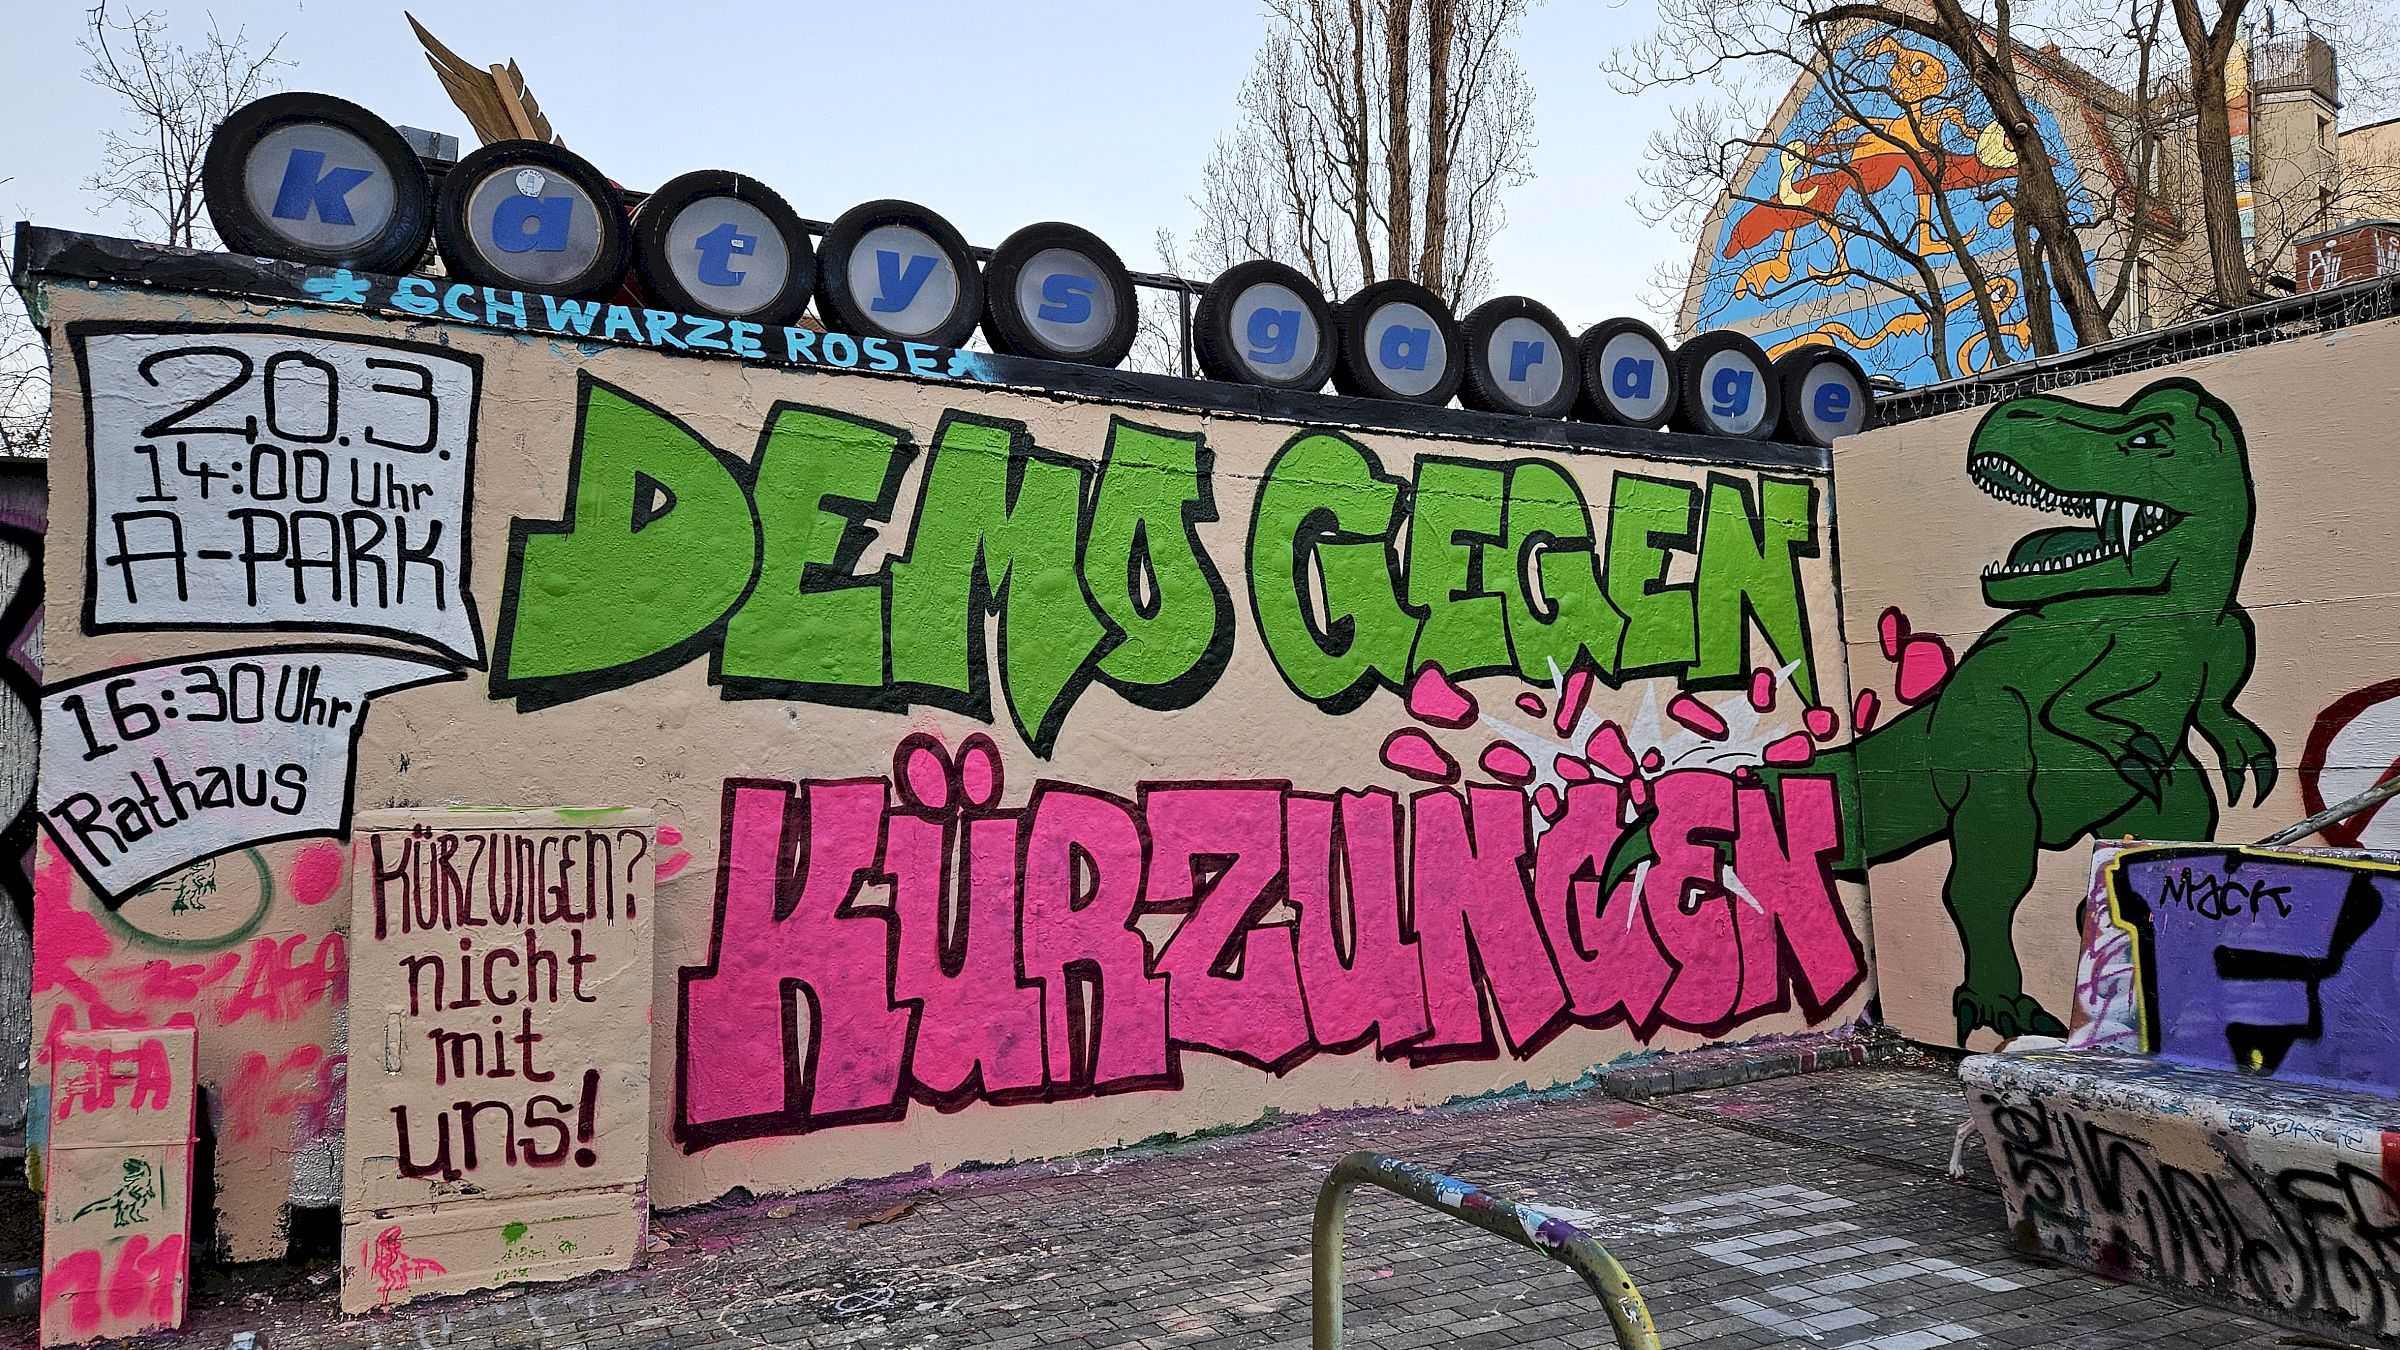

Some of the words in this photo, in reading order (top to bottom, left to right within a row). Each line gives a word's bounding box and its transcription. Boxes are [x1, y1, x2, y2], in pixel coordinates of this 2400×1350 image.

[138, 346, 451, 461] 20.3.
[784, 326, 938, 376] ROSE
[134, 442, 330, 504] 14:00
[350, 457, 434, 513] Uhr
[106, 508, 446, 611] A-PARK
[489, 368, 1236, 761] DEMO
[1245, 428, 1822, 716] GEGEN
[61, 661, 266, 761] 16:30
[274, 661, 353, 730] Uhr
[50, 757, 308, 867] Rathaus
[369, 824, 649, 941] KÜRZUNGEN?
[400, 928, 598, 1017] nicht
[672, 731, 1868, 1156] KÜRZUNGEN
[426, 1008, 554, 1085] mit
[390, 1068, 600, 1181] uns!
